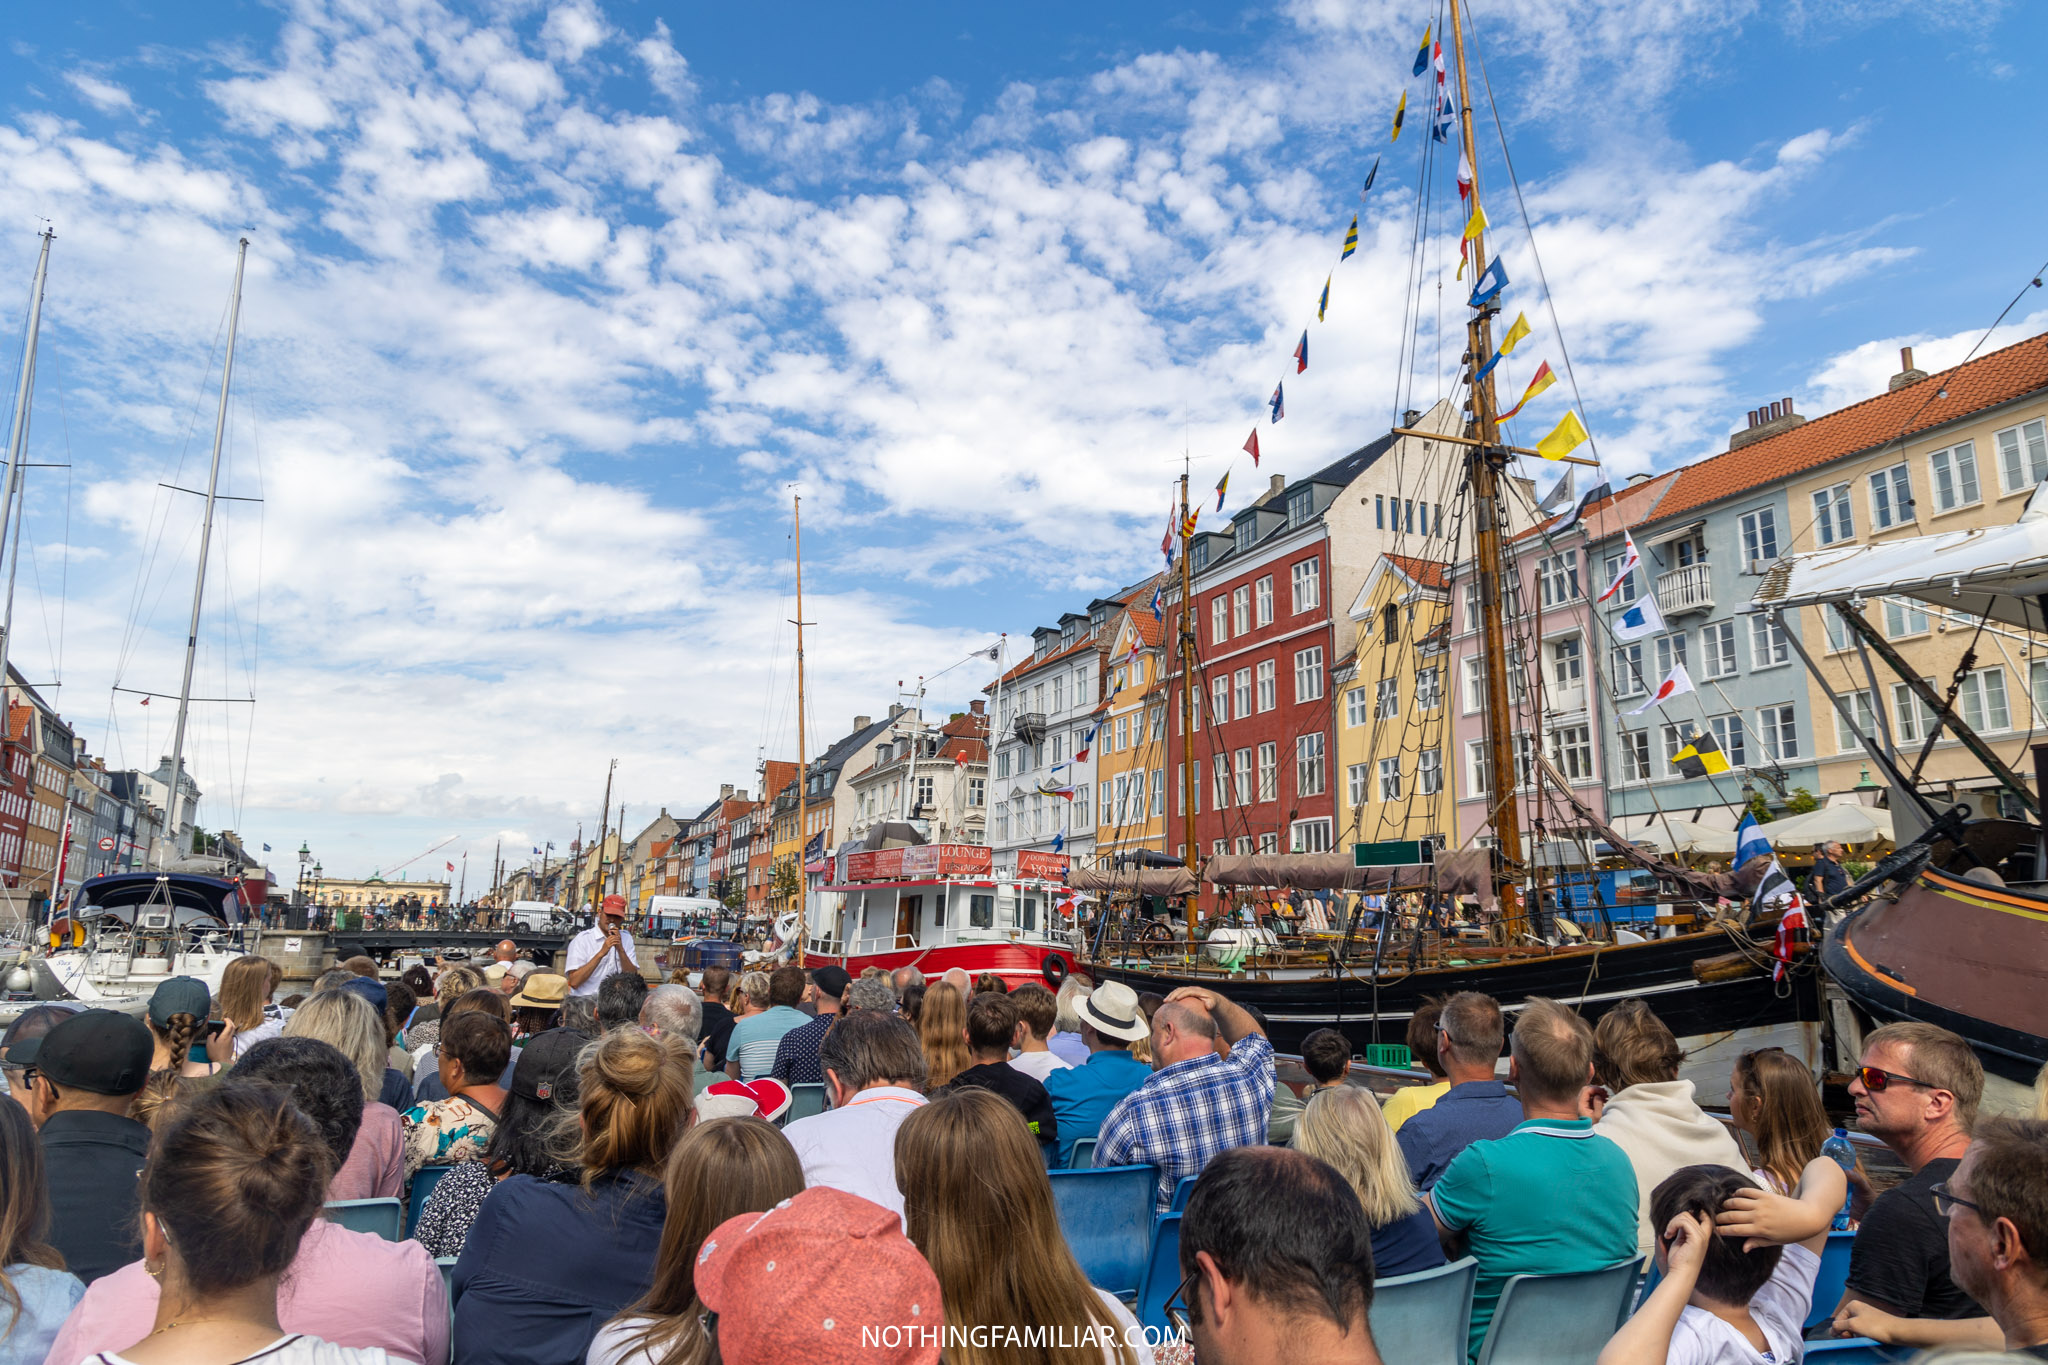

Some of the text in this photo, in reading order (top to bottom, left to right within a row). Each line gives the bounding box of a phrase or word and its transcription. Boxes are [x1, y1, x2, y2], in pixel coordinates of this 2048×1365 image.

[941, 847, 987, 859] LOUNGE
[1030, 854, 1069, 865] DOWNSTAIRS
[945, 863, 981, 872] UPSTAIRS
[1031, 864, 1062, 877] HOTE
